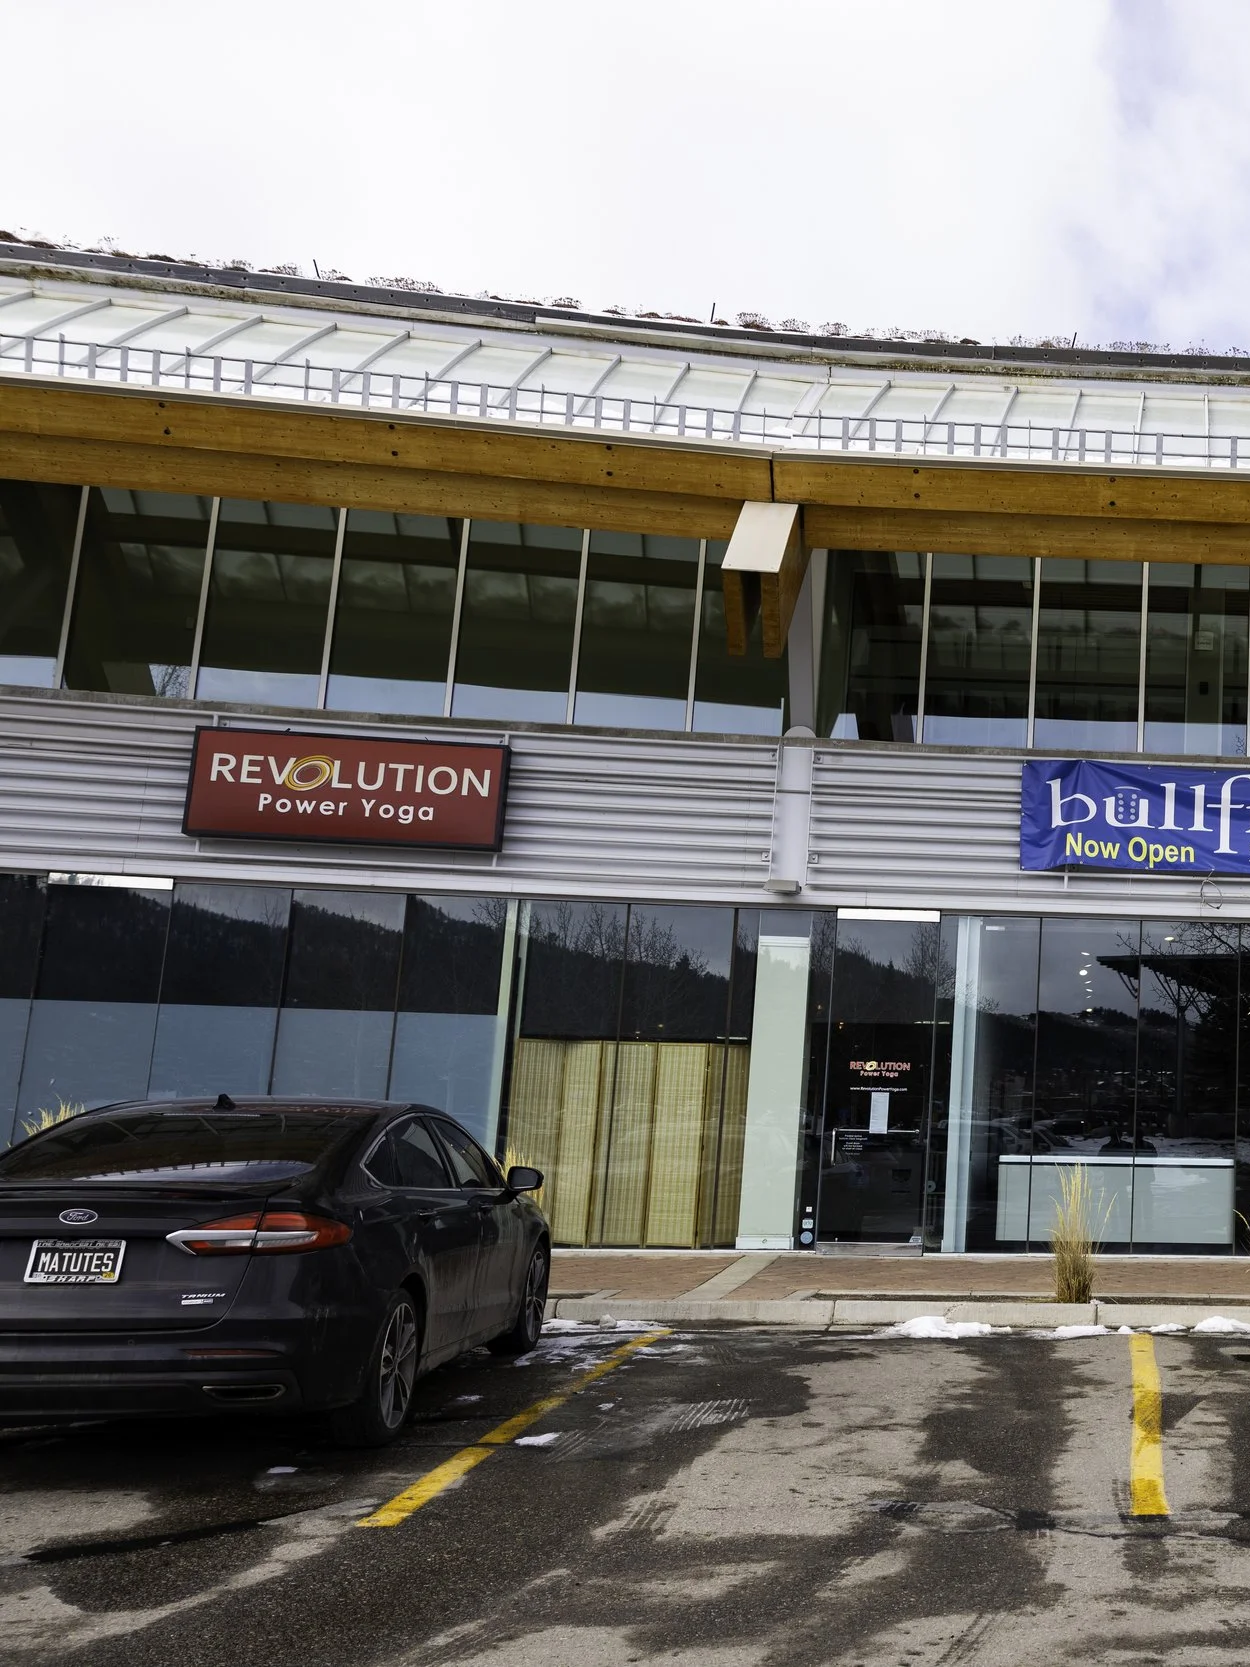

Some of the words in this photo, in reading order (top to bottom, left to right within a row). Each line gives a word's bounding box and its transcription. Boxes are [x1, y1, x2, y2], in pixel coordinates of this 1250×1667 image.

[209, 752, 491, 798] REVOLUTION
[258, 793, 348, 817] Power
[361, 798, 434, 825] Yoga
[1065, 832, 1120, 861] Now
[1127, 836, 1195, 868] Open
[849, 1061, 911, 1071] REVOLUTION
[67, 1211, 90, 1221] Ford
[38, 1252, 114, 1272] MATUTES
